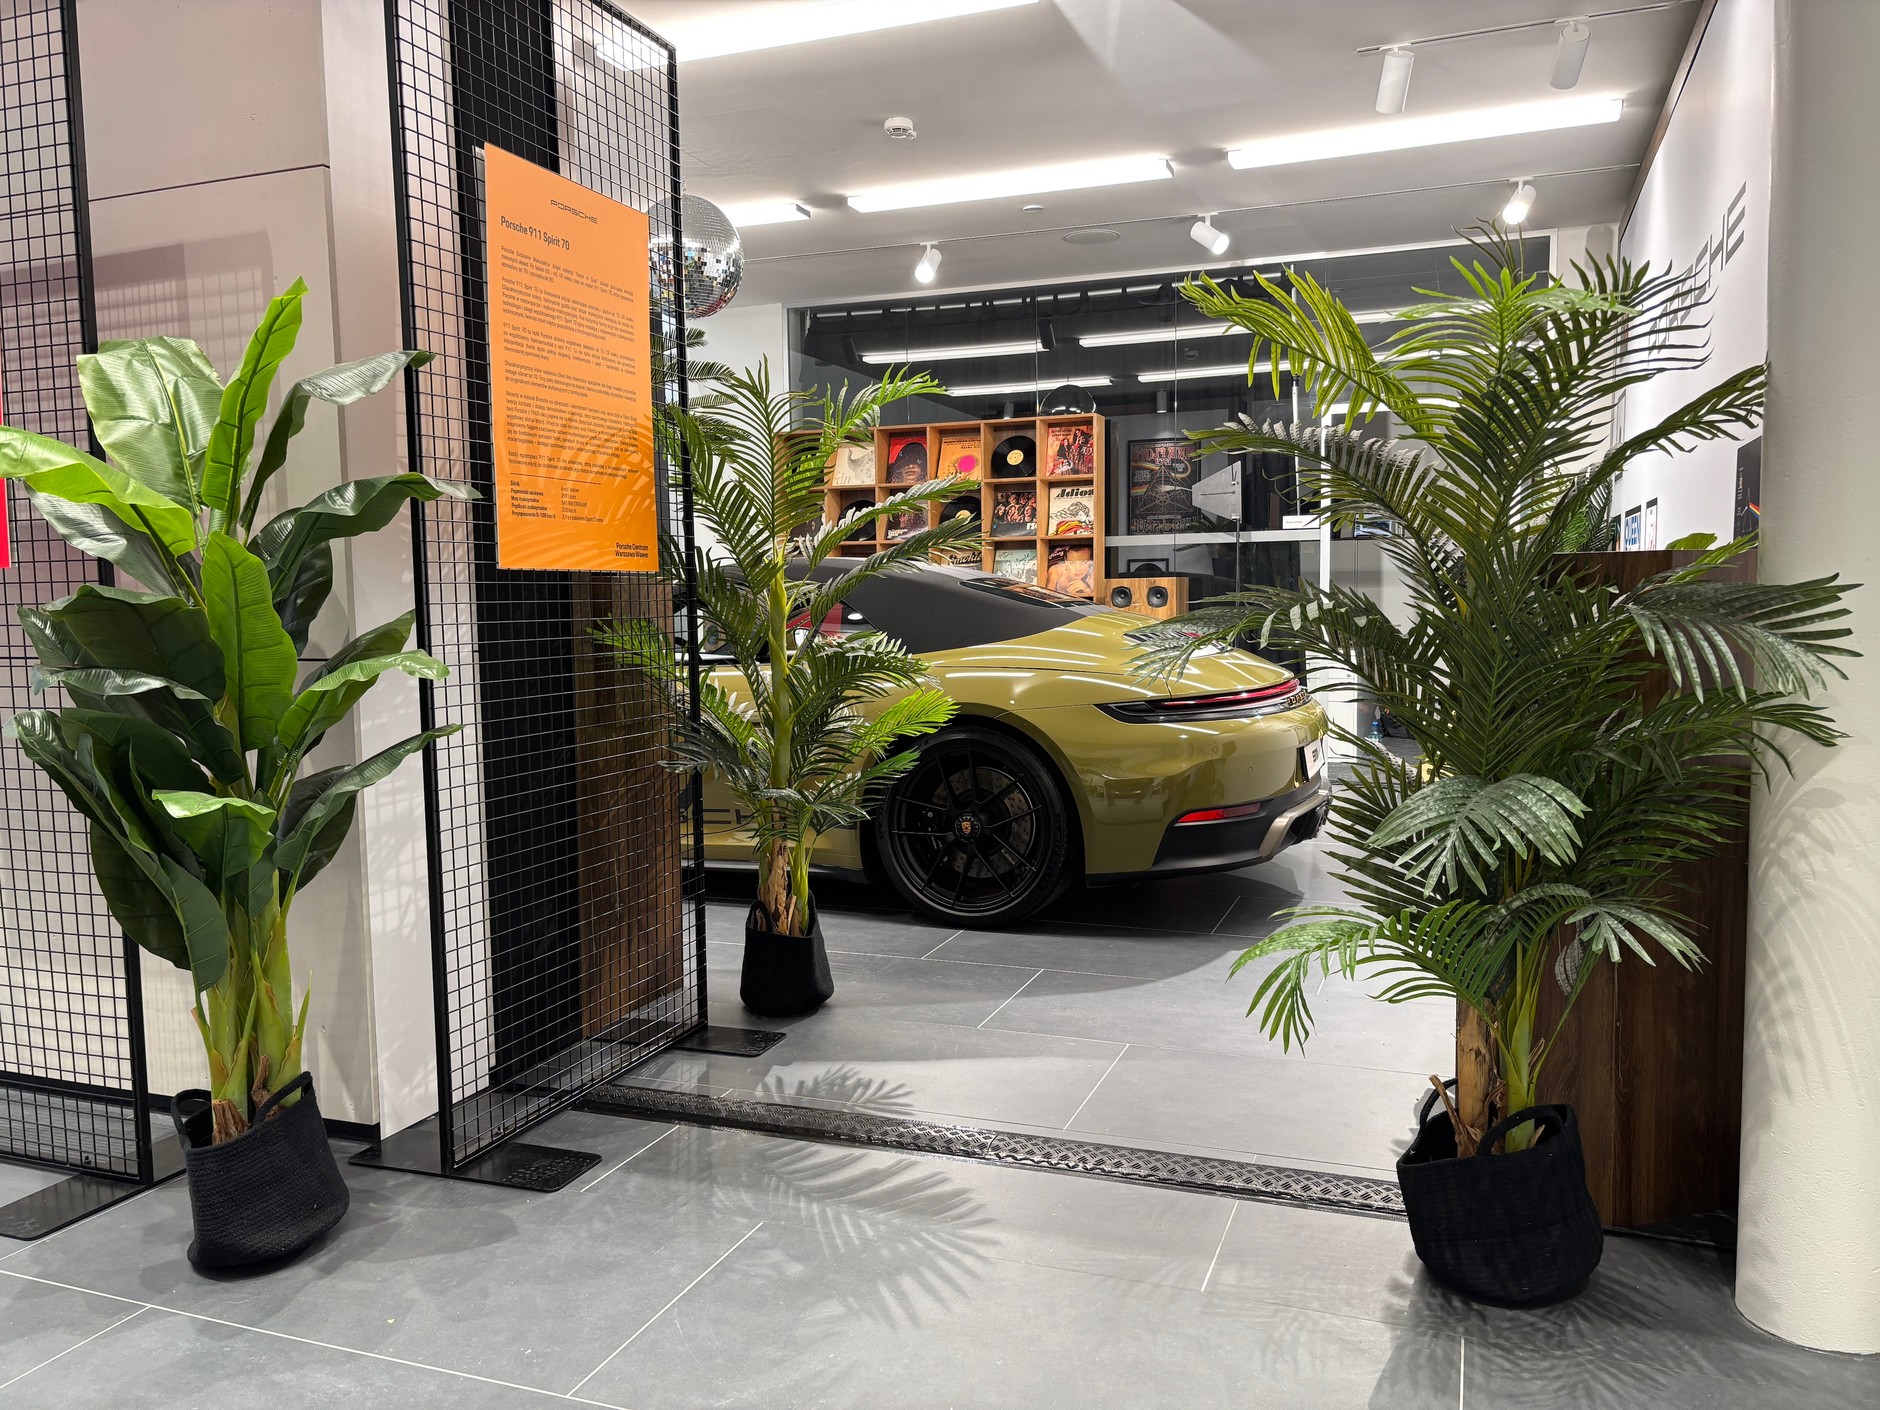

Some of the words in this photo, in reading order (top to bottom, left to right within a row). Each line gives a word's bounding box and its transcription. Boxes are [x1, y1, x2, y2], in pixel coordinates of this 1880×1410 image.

[550, 198, 598, 225] PORSCHE
[501, 215, 528, 236] Porsche
[529, 226, 542, 240] 911
[543, 231, 560, 249] Spirit
[561, 238, 570, 251] 70
[616, 542, 632, 550] Porsche
[632, 543, 649, 551] Centrum
